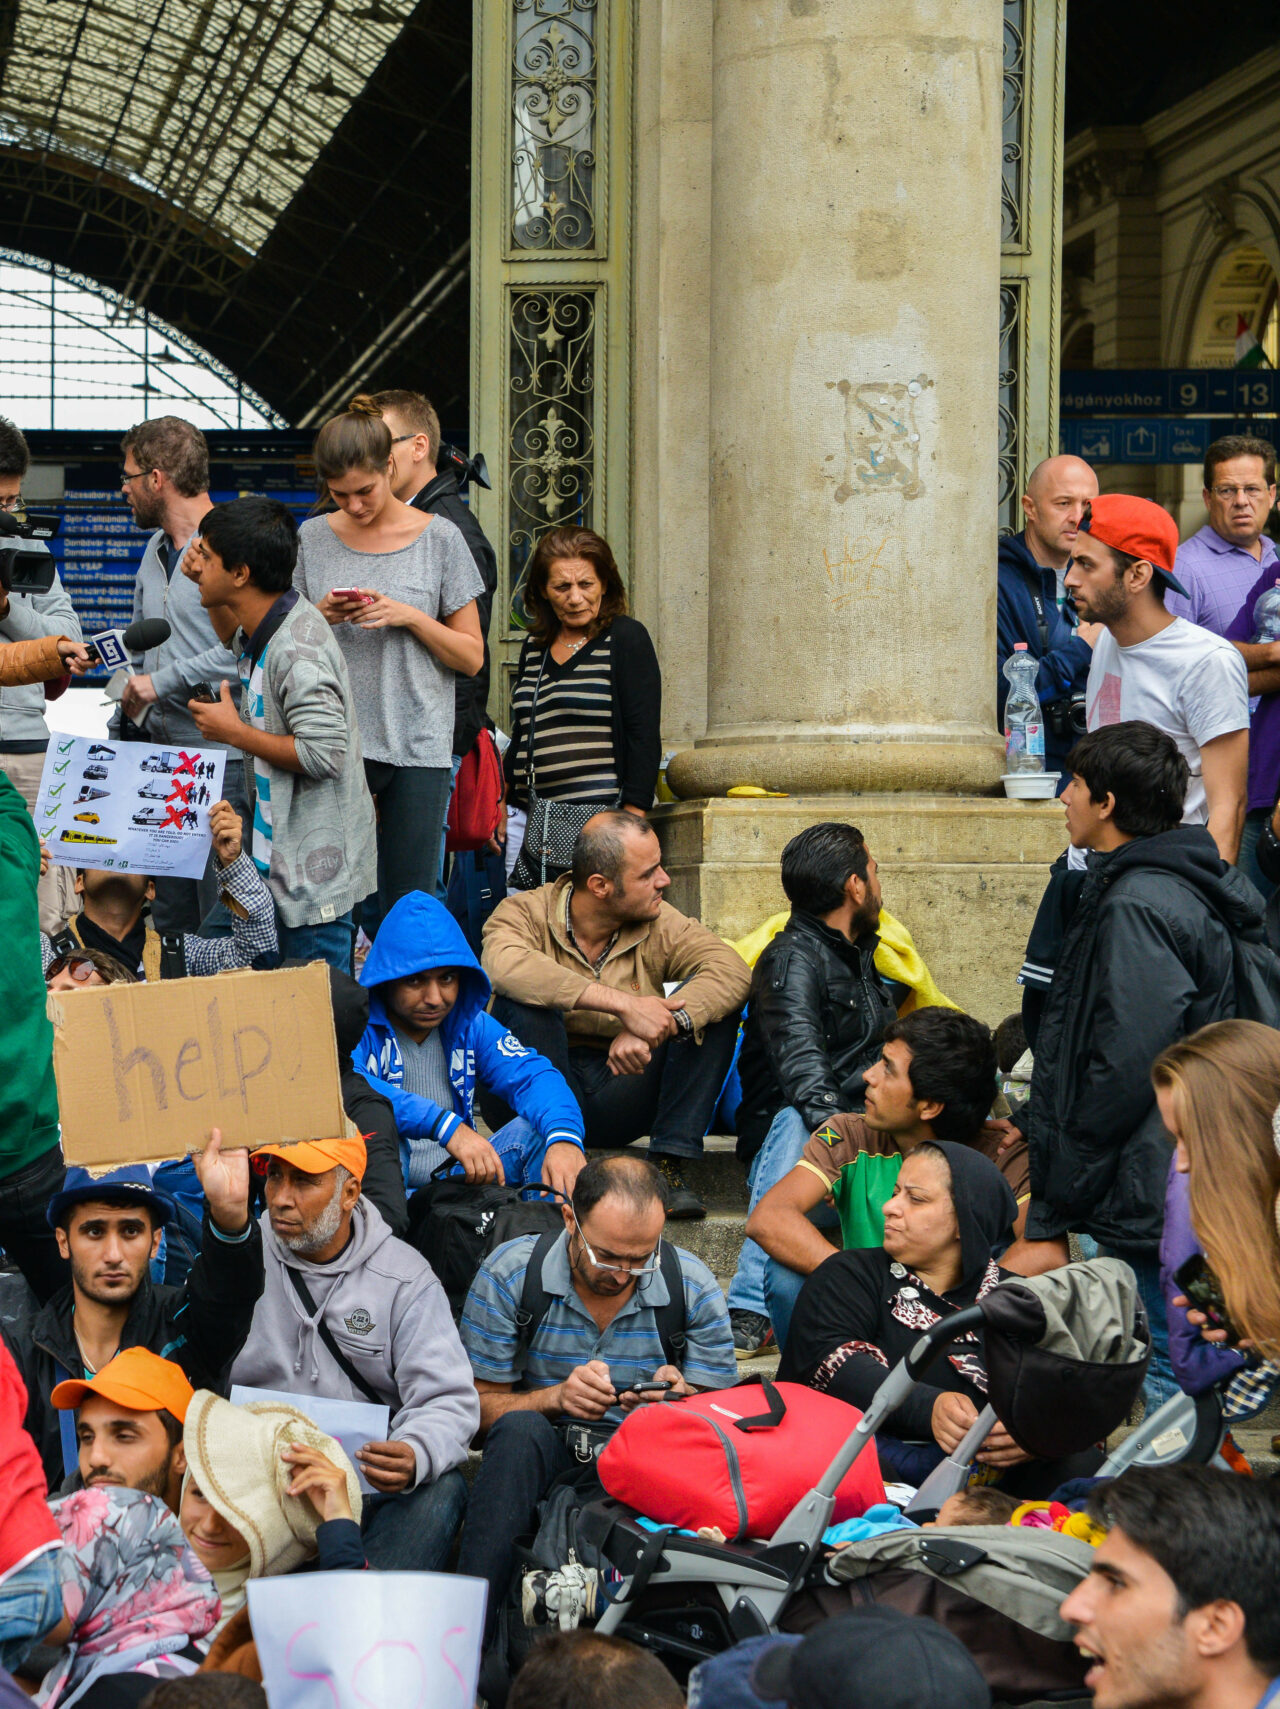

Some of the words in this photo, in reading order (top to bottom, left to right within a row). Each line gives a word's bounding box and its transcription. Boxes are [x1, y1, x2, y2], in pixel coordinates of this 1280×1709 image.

[1180, 383, 1198, 406] 9
[1238, 383, 1270, 406] 13
[285, 1620, 468, 1709] SOS
